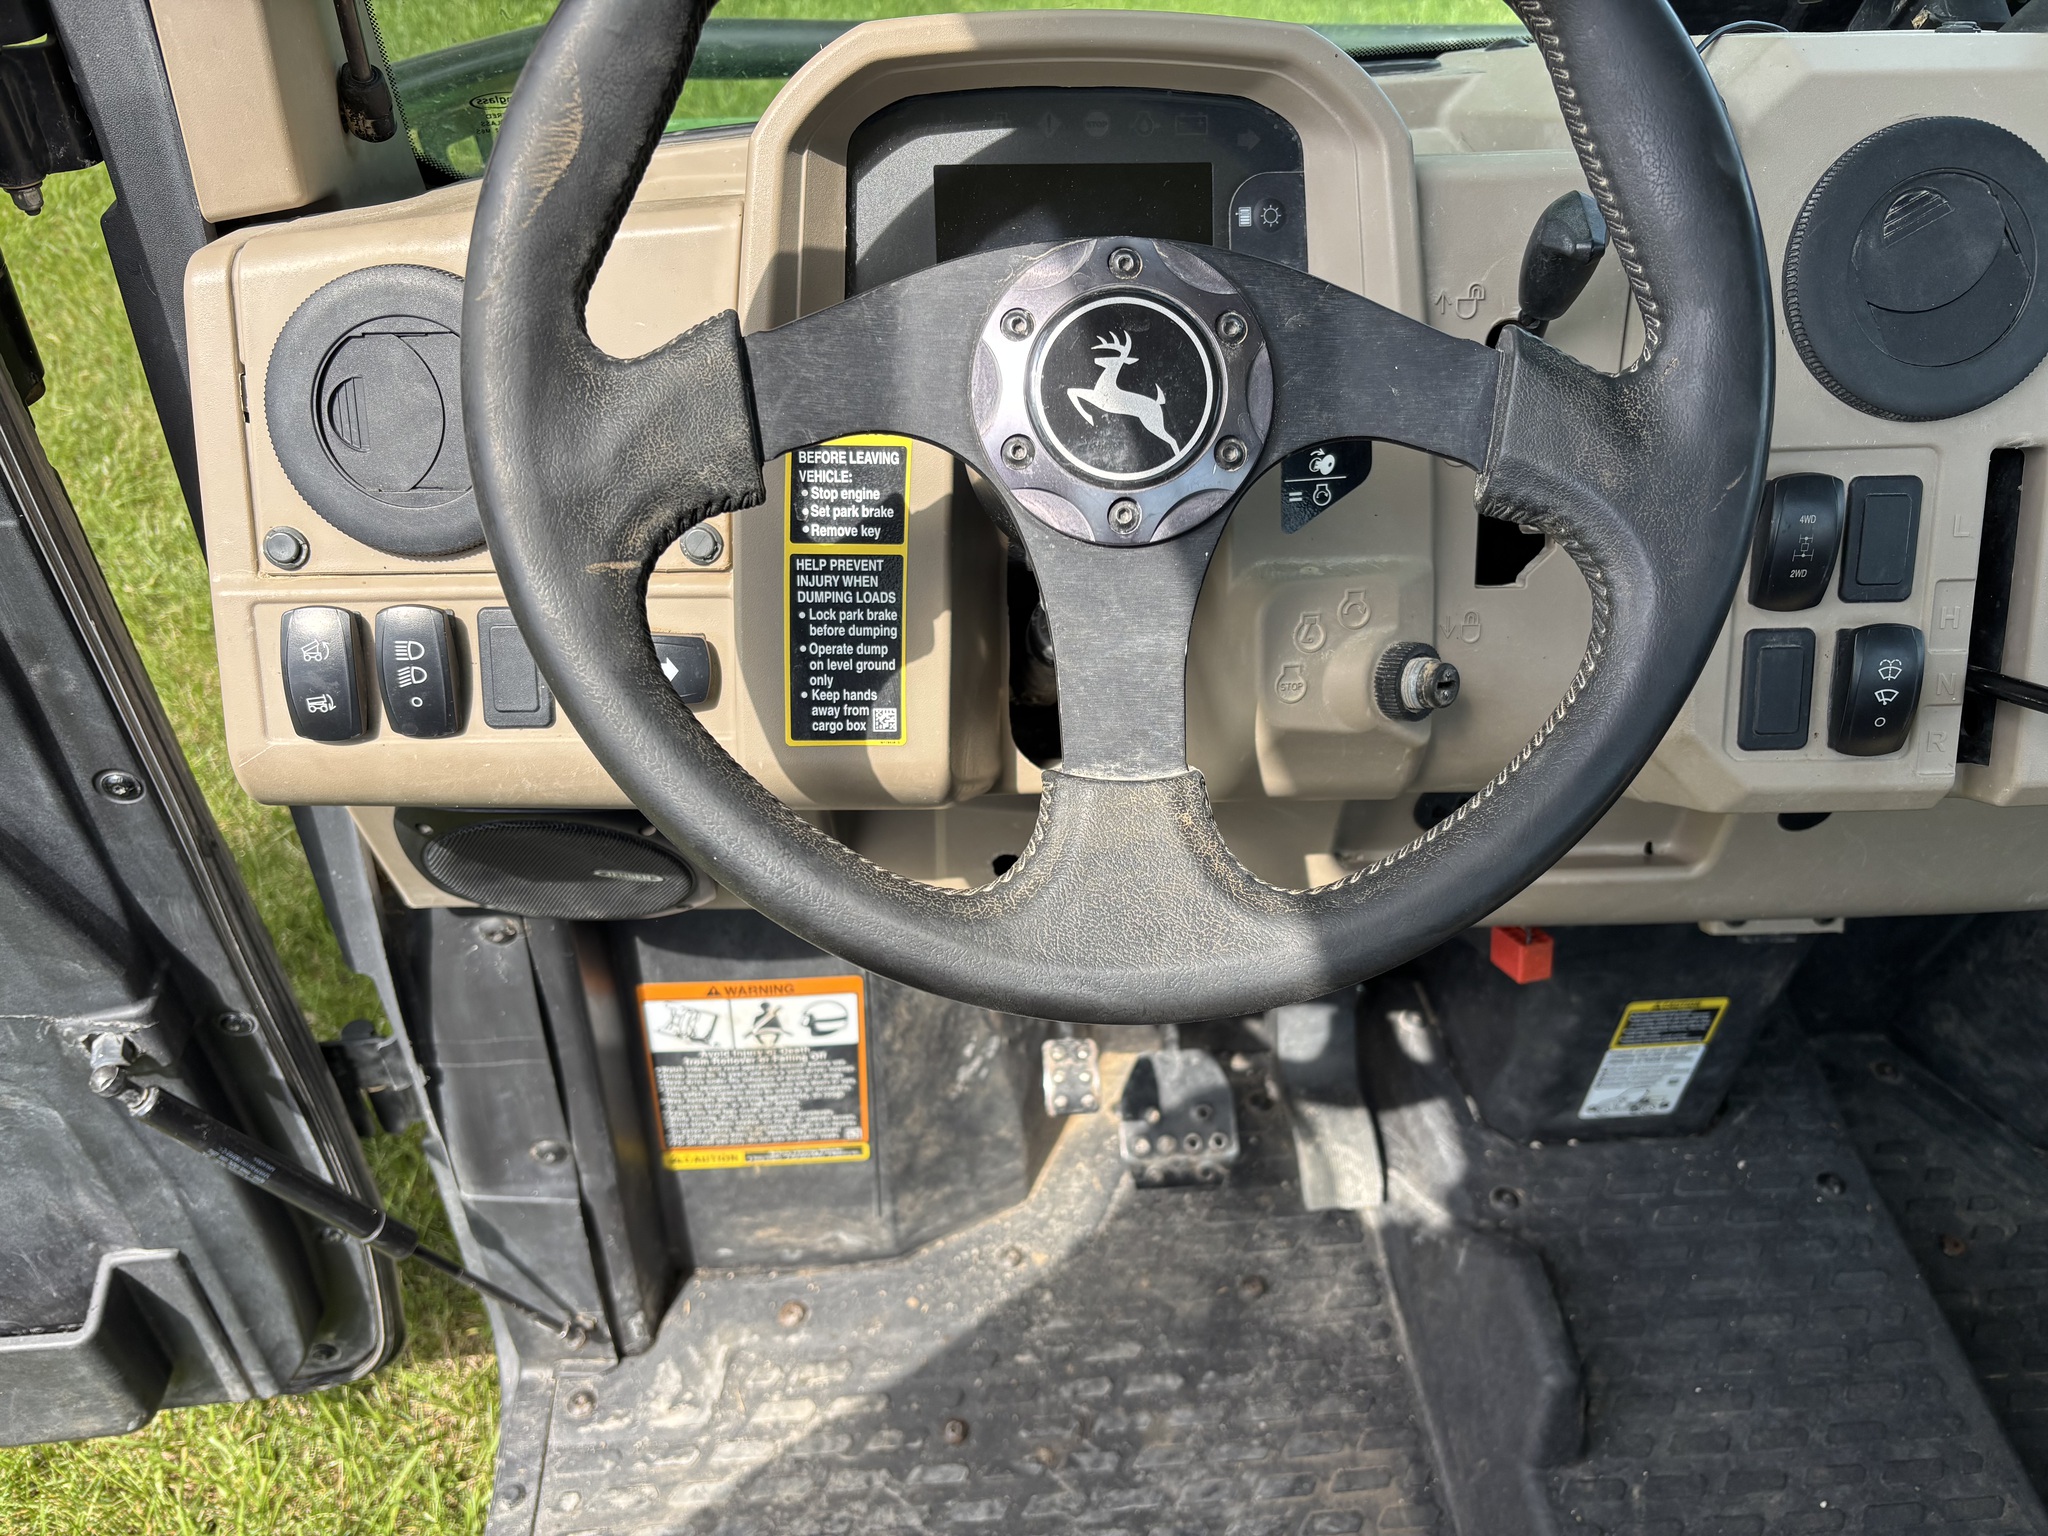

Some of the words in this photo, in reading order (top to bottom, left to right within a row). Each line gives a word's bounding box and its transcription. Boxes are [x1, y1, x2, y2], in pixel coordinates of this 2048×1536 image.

[799, 451, 847, 464] BEFORE
[849, 451, 900, 464] LEAVING
[799, 470, 853, 483] VEHICLE:
[811, 486, 838, 502] Stop
[841, 487, 880, 503] engine
[810, 504, 831, 518] Set
[833, 505, 859, 520] park
[862, 505, 894, 518] brake
[1800, 514, 1817, 524] 4WD
[811, 524, 858, 537] Remove
[861, 525, 881, 540] key
[1953, 514, 1970, 537] L
[796, 559, 827, 571] HELP
[830, 559, 884, 571] PREVENT
[797, 575, 840, 587] INJURY
[842, 575, 878, 587] WHEN
[1789, 569, 1808, 578] 2WD
[797, 591, 853, 603] DUMPING
[856, 591, 896, 604] LOADS
[809, 608, 836, 621] Lock
[839, 608, 864, 623] park
[866, 608, 898, 621] brake
[1939, 606, 1961, 629] H
[809, 624, 846, 636] before
[848, 624, 898, 639] dumping
[809, 642, 853, 657] Operate
[856, 643, 888, 657] dump
[809, 661, 824, 670] on
[827, 658, 853, 670] level
[856, 658, 896, 673] ground
[809, 674, 834, 688] only
[1280, 682, 1304, 691] STOP
[1936, 672, 1956, 695] N
[811, 689, 840, 703] Keep
[843, 689, 878, 701] hands
[811, 706, 840, 719] away
[843, 704, 869, 716] from
[812, 721, 843, 734] cargo
[846, 719, 867, 731] box
[1926, 731, 1947, 752] R
[724, 983, 795, 997] WARNING
